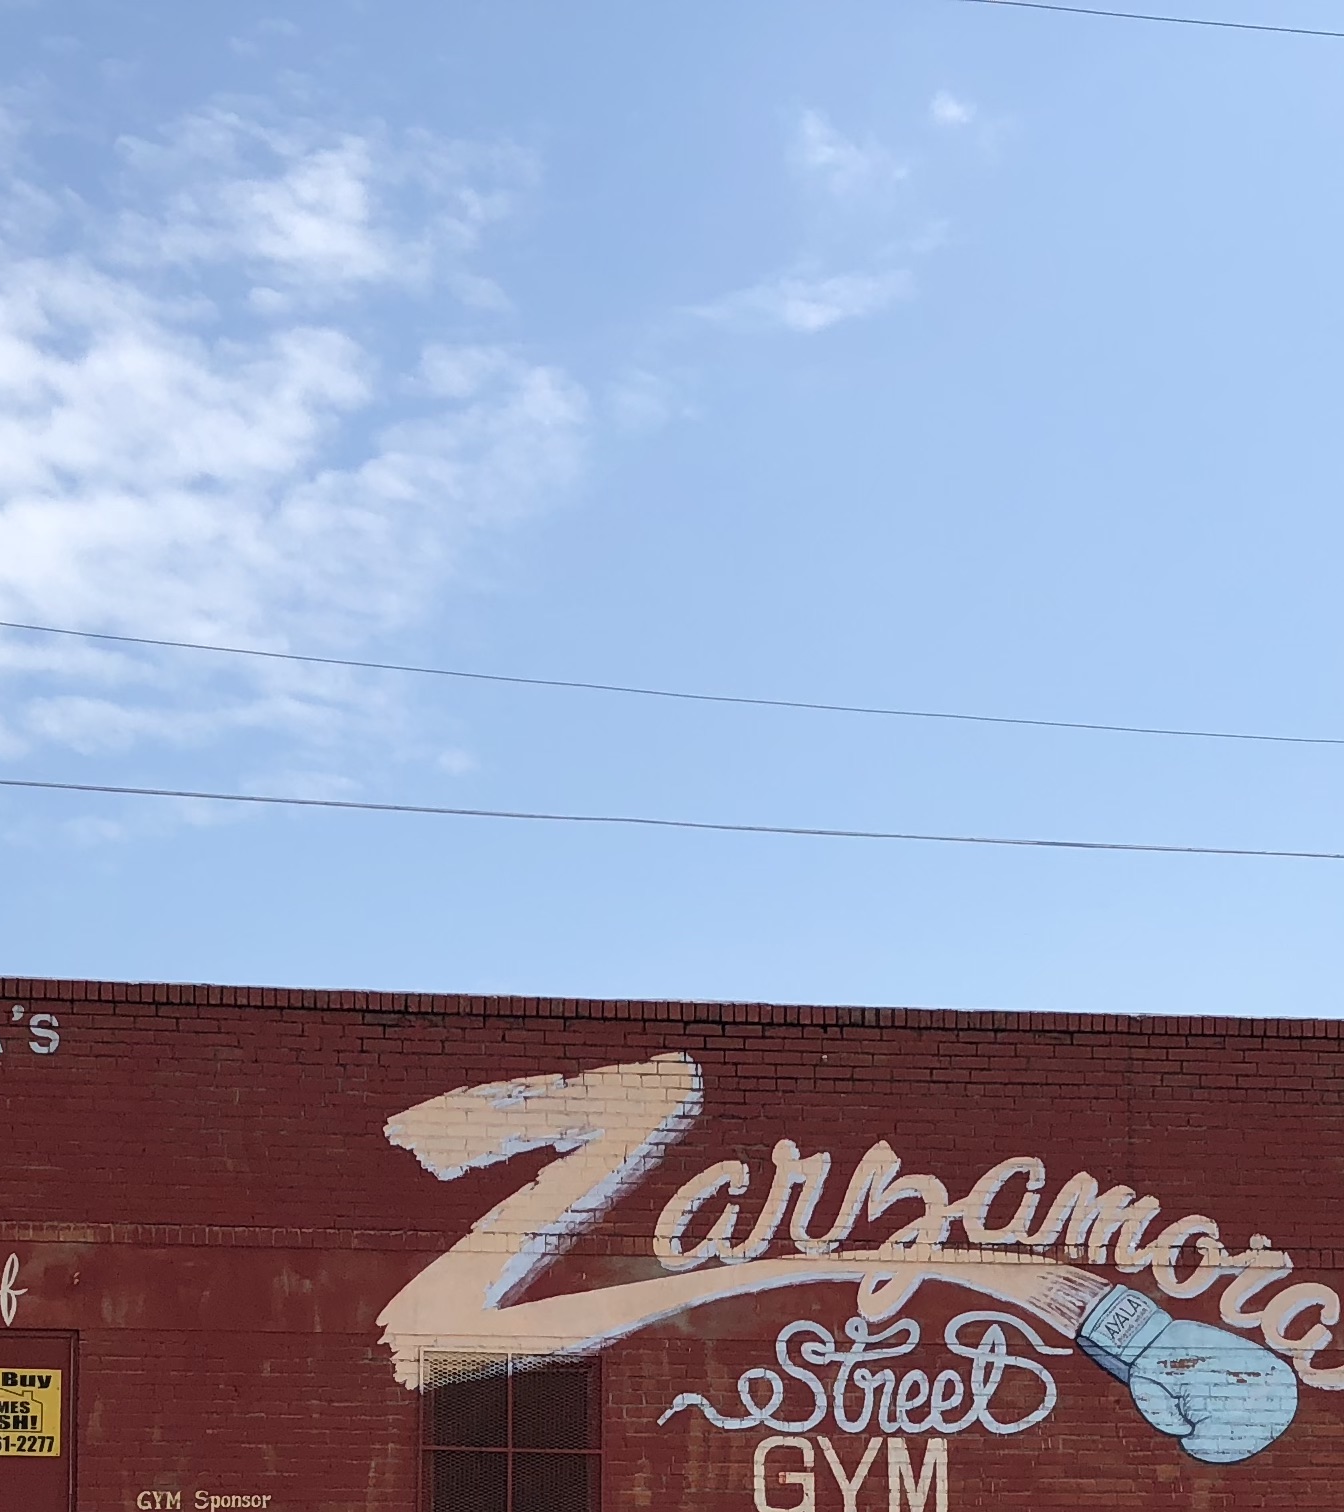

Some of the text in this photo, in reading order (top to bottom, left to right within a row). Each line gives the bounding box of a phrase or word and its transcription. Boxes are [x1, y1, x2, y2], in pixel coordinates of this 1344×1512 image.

[1104, 1298, 1143, 1341] AYALA
[1, 1371, 53, 1389] Buy
[656, 1310, 1073, 1434] Street
[137, 1490, 181, 1510] GYM
